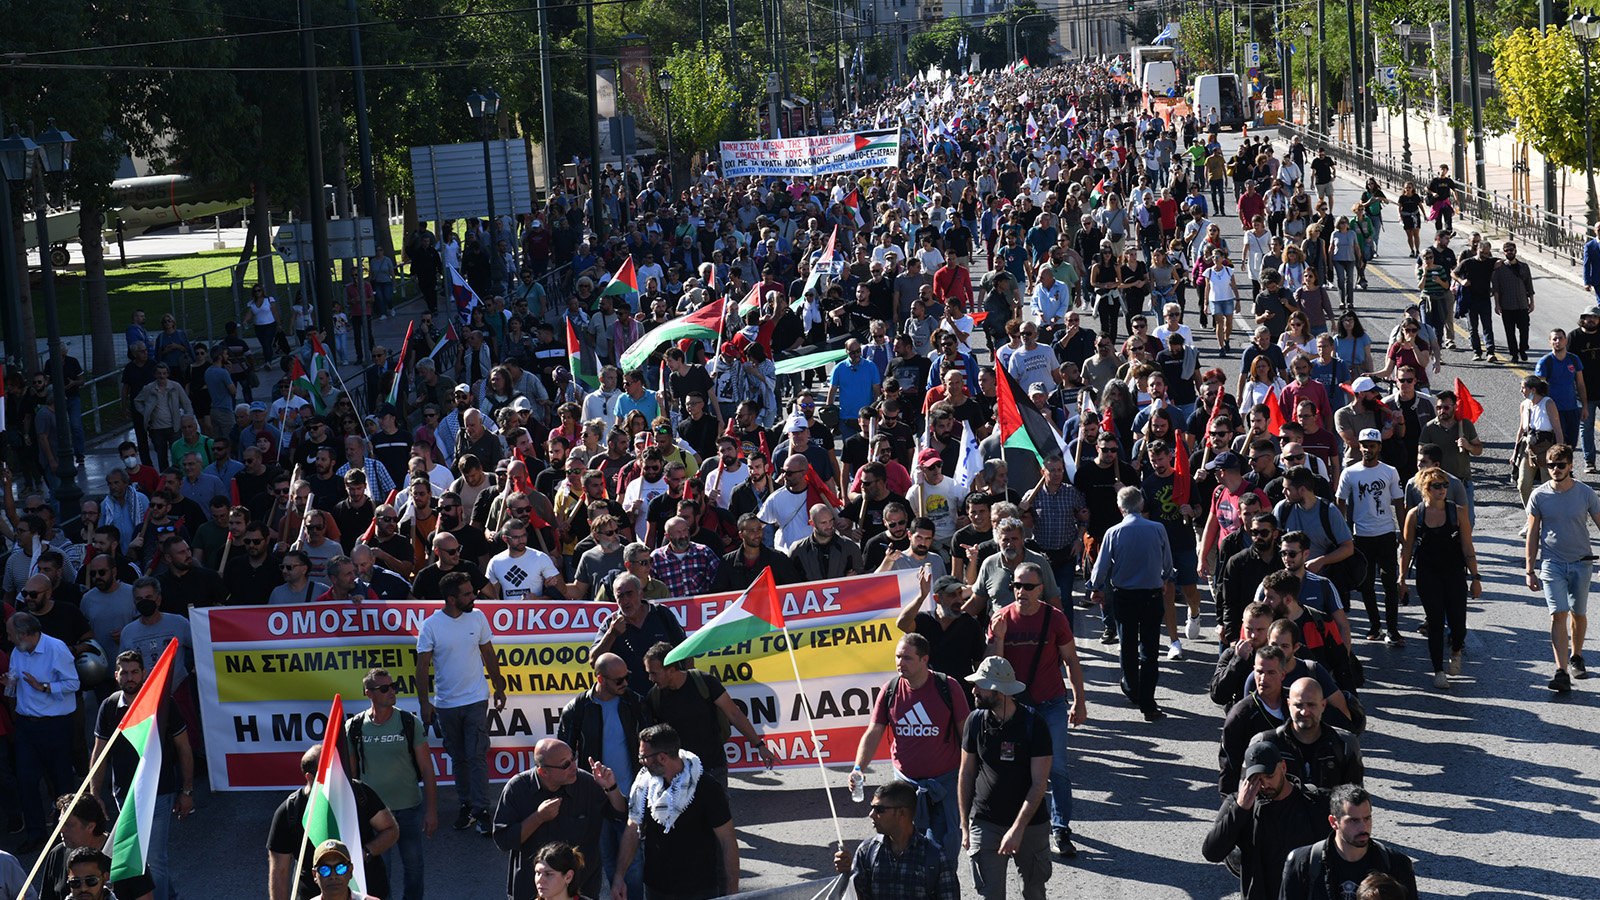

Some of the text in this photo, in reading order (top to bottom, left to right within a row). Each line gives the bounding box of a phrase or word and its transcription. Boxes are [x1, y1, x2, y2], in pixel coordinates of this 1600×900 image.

[722, 134, 851, 151] ΝΙΚΗ ΣΤΟΝ ΑΓΩΝΑ ΤΗΣ ΠΑΛΑΙΣΤΙΝΗΣ
[724, 160, 736, 169] ΟΧΙ
[785, 155, 830, 167] ΔΟΛΟΦΟΝΟΥΣ
[736, 146, 832, 160] ΕΙΜΑΣΤΕ ΜΕ ΤΟΥΣ ΛΑΟΥΣ
[267, 608, 441, 636] ΟΜΟΣΠΟΝ
[492, 605, 687, 632] ΟΙΚΟΔΟΝ
[225, 654, 256, 673] ΝΑ
[262, 648, 402, 673] ΣΤΑΜΑΤΗΣΕΙ
[496, 646, 589, 667] ΔΟΛΟΦΟ
[760, 632, 803, 652] ΤΟΥ
[810, 623, 892, 648] ΙΣΡΑΗΛ
[529, 672, 594, 692] ΠΑΛΑΙ
[234, 716, 260, 742] Η
[896, 724, 940, 736] adidas
[723, 734, 830, 764] ΘΗΝΑΣ
